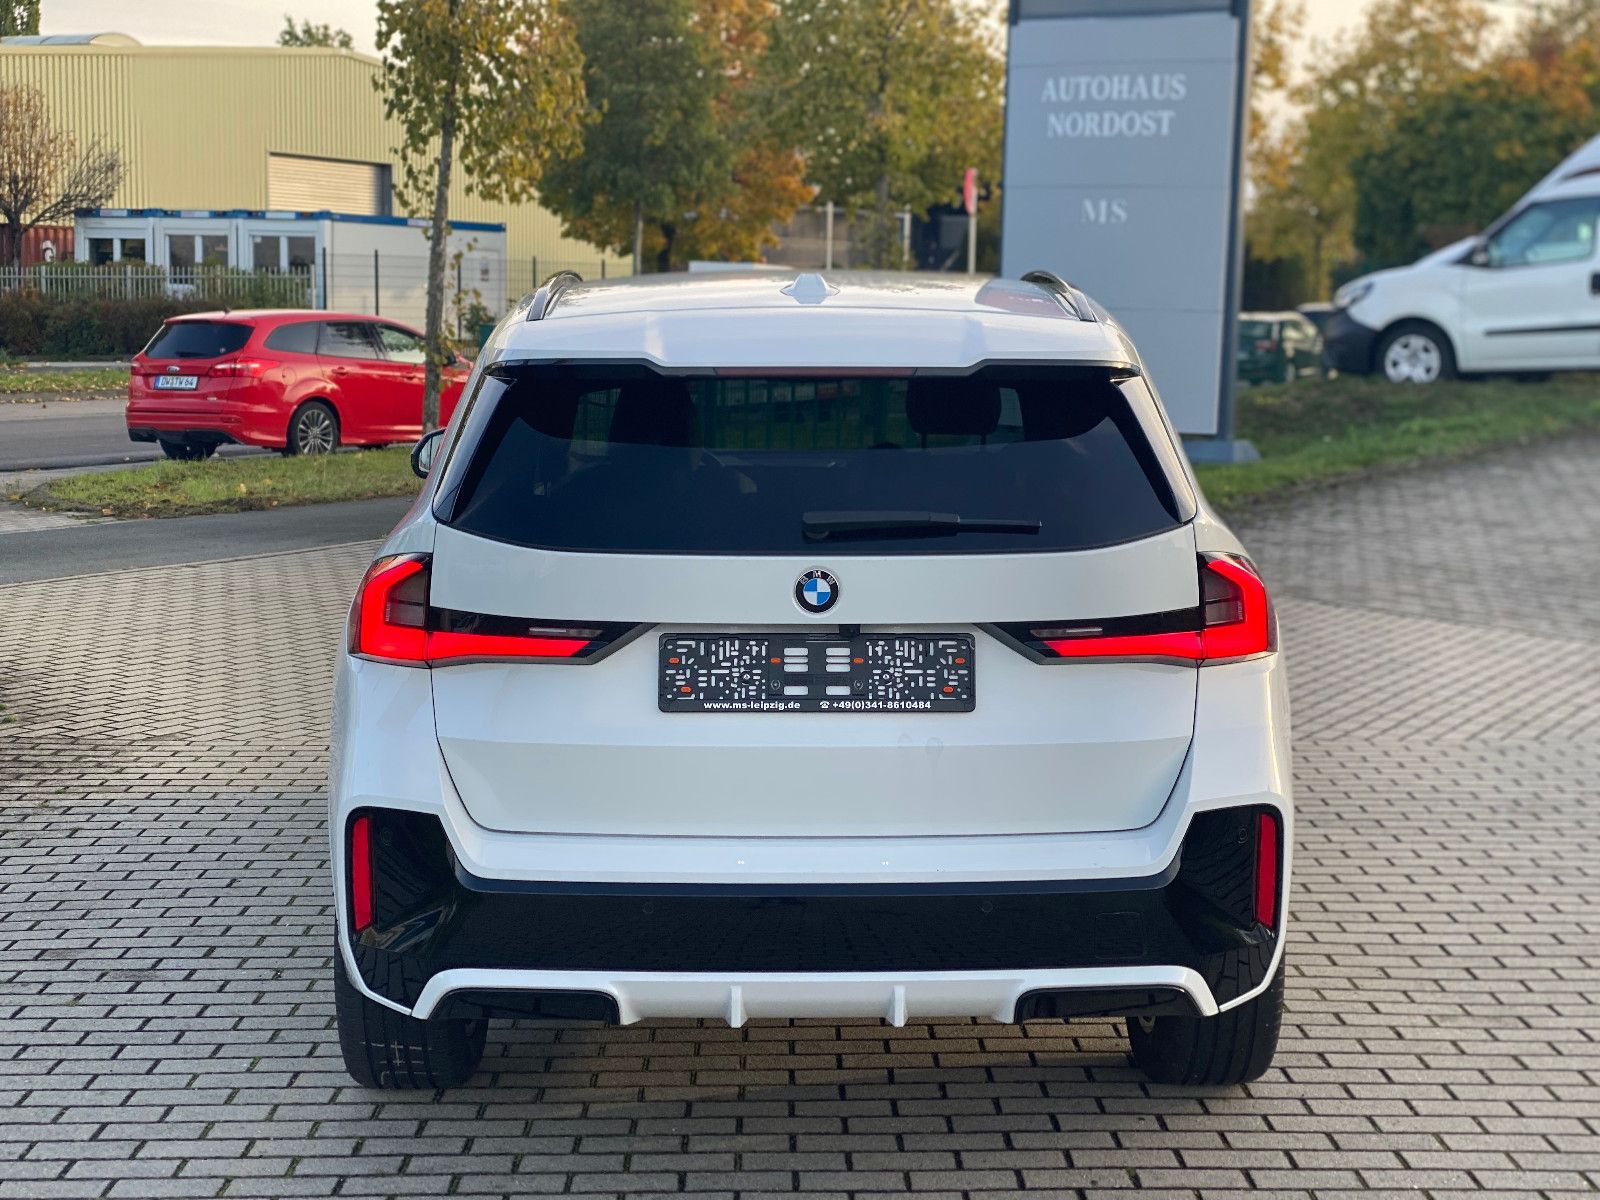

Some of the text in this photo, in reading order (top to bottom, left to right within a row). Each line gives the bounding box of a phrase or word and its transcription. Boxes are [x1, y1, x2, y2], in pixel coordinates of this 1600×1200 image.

[1041, 73, 1188, 102] AUTOHAUS
[1047, 109, 1176, 137] NORDOST
[1081, 198, 1128, 224] MS
[800, 570, 836, 585] BMW
[703, 701, 932, 711] www.ms-leipzig.de +49(0)341-8610484
